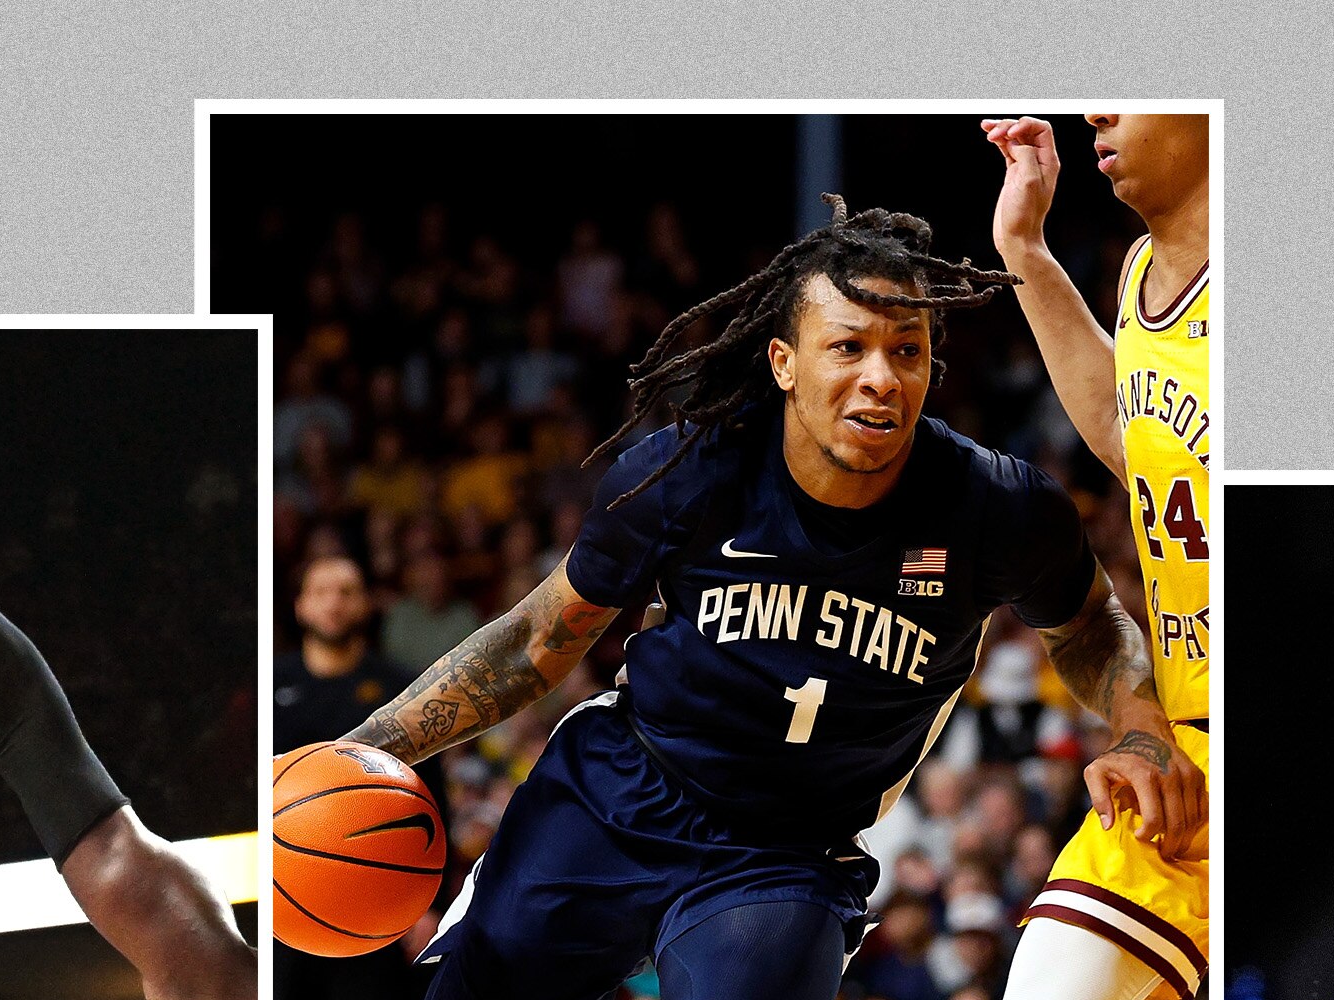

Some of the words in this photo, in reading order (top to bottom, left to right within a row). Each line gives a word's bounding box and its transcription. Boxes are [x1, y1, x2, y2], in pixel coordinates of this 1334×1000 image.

[1188, 320, 1209, 338] B1
[1136, 477, 1209, 560] 24
[898, 579, 944, 597] B1G
[697, 583, 808, 643] PENN
[815, 590, 937, 684] STATE
[783, 677, 828, 743] 1
